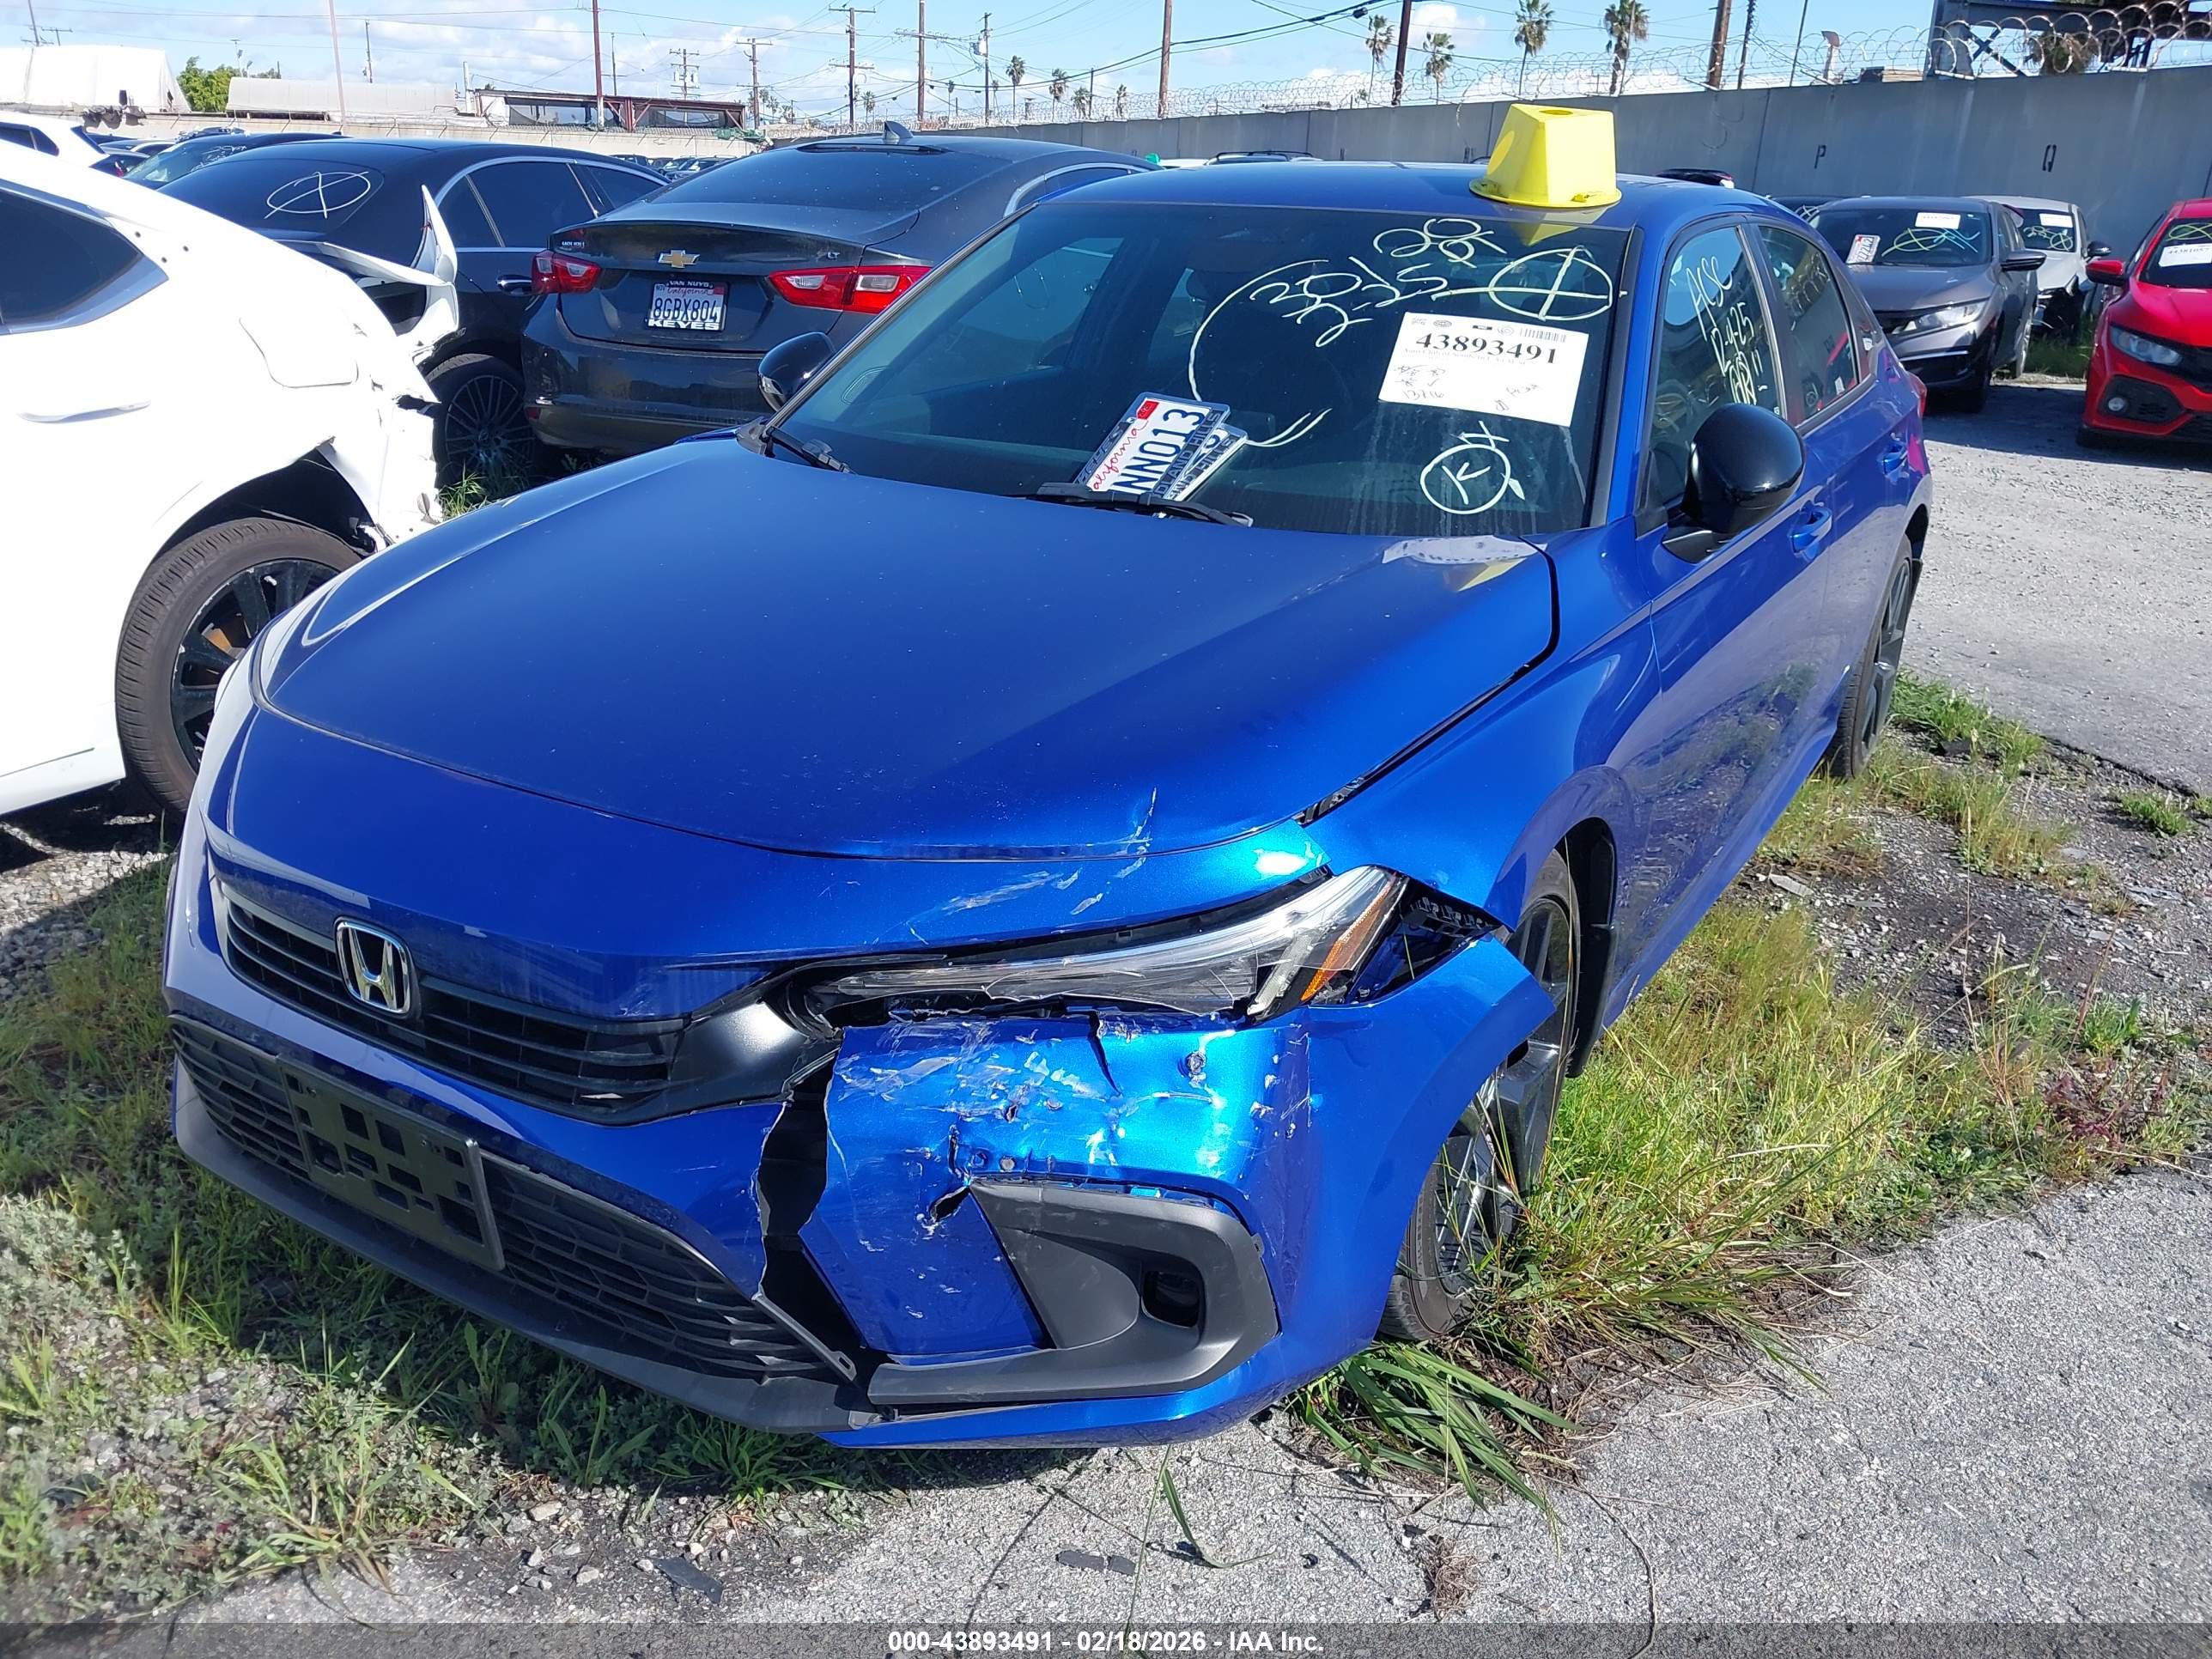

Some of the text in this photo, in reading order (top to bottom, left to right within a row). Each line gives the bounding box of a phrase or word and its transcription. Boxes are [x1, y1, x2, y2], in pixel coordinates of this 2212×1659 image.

[1814, 144, 1827, 169] P
[647, 319, 720, 331] KEYES
[653, 297, 718, 321] 8GBX804
[1415, 332, 1557, 365] 43893491
[1093, 420, 1149, 491] alifornia
[1113, 408, 1206, 492] NN013
[1153, 449, 1194, 496] DLAND
[1189, 410, 1221, 447] HILLS
